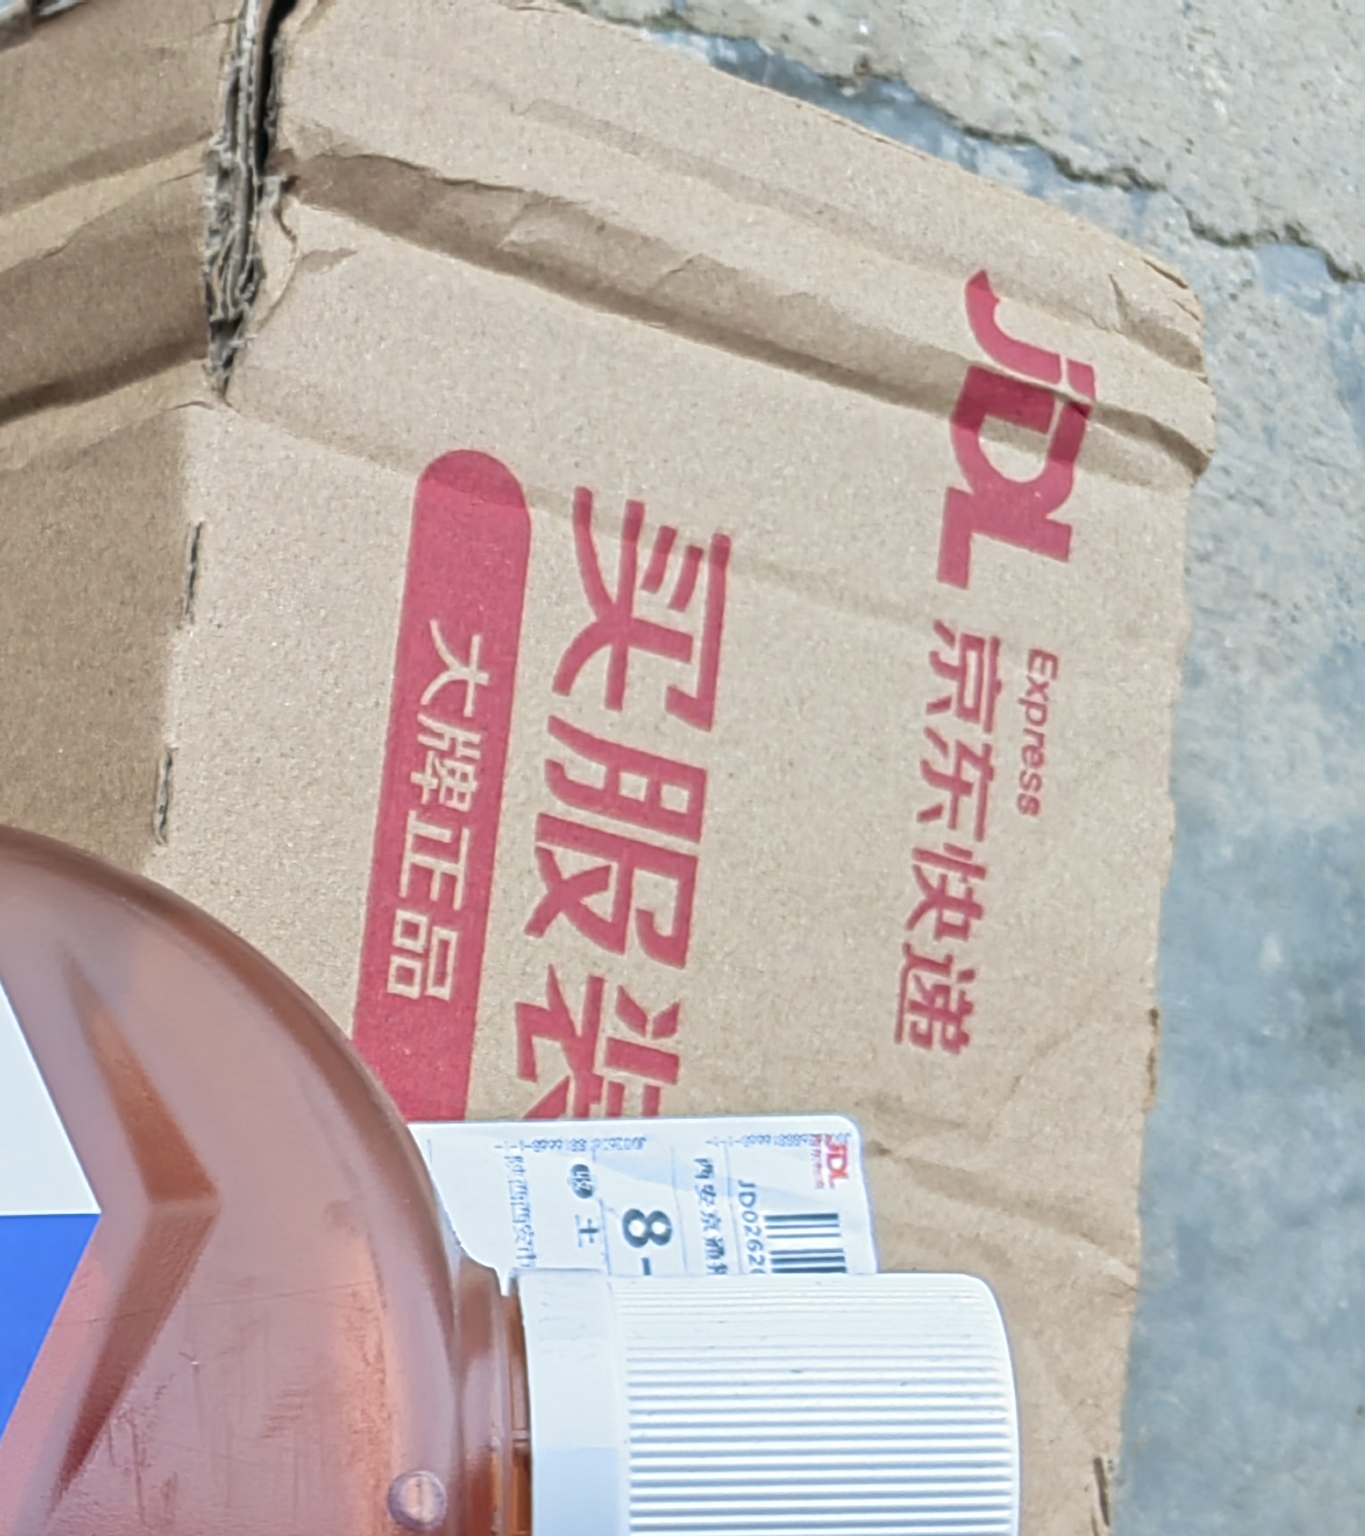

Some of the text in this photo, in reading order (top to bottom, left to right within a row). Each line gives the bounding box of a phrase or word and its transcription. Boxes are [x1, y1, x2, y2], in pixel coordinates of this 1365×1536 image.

[937, 270, 1096, 590] JDL
[385, 619, 492, 1001] 大牌正品
[515, 486, 733, 1119] 买服装
[892, 619, 1003, 1054] 京东快递
[1017, 648, 1059, 818] Express
